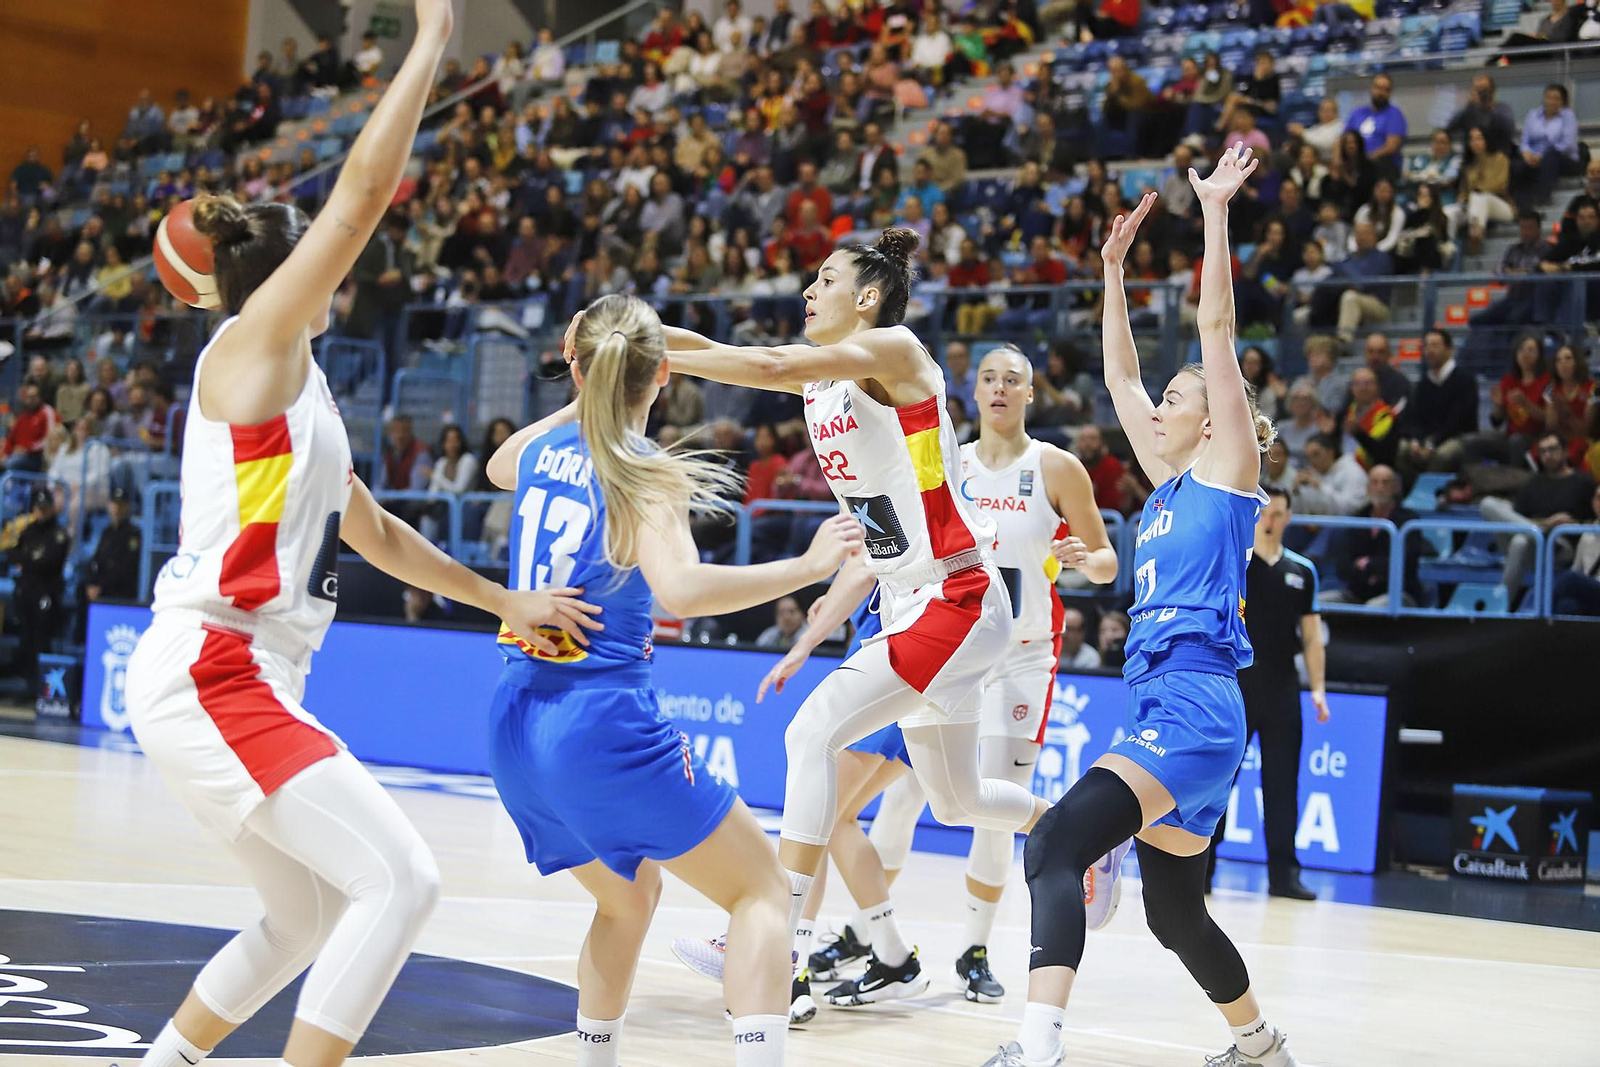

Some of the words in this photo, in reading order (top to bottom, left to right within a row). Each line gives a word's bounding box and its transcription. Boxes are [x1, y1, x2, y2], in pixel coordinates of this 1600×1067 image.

[818, 450, 857, 481] 22
[518, 486, 591, 591] 13
[714, 692, 745, 725] de
[1309, 741, 1347, 778] de
[1453, 852, 1529, 880] CaixaBank
